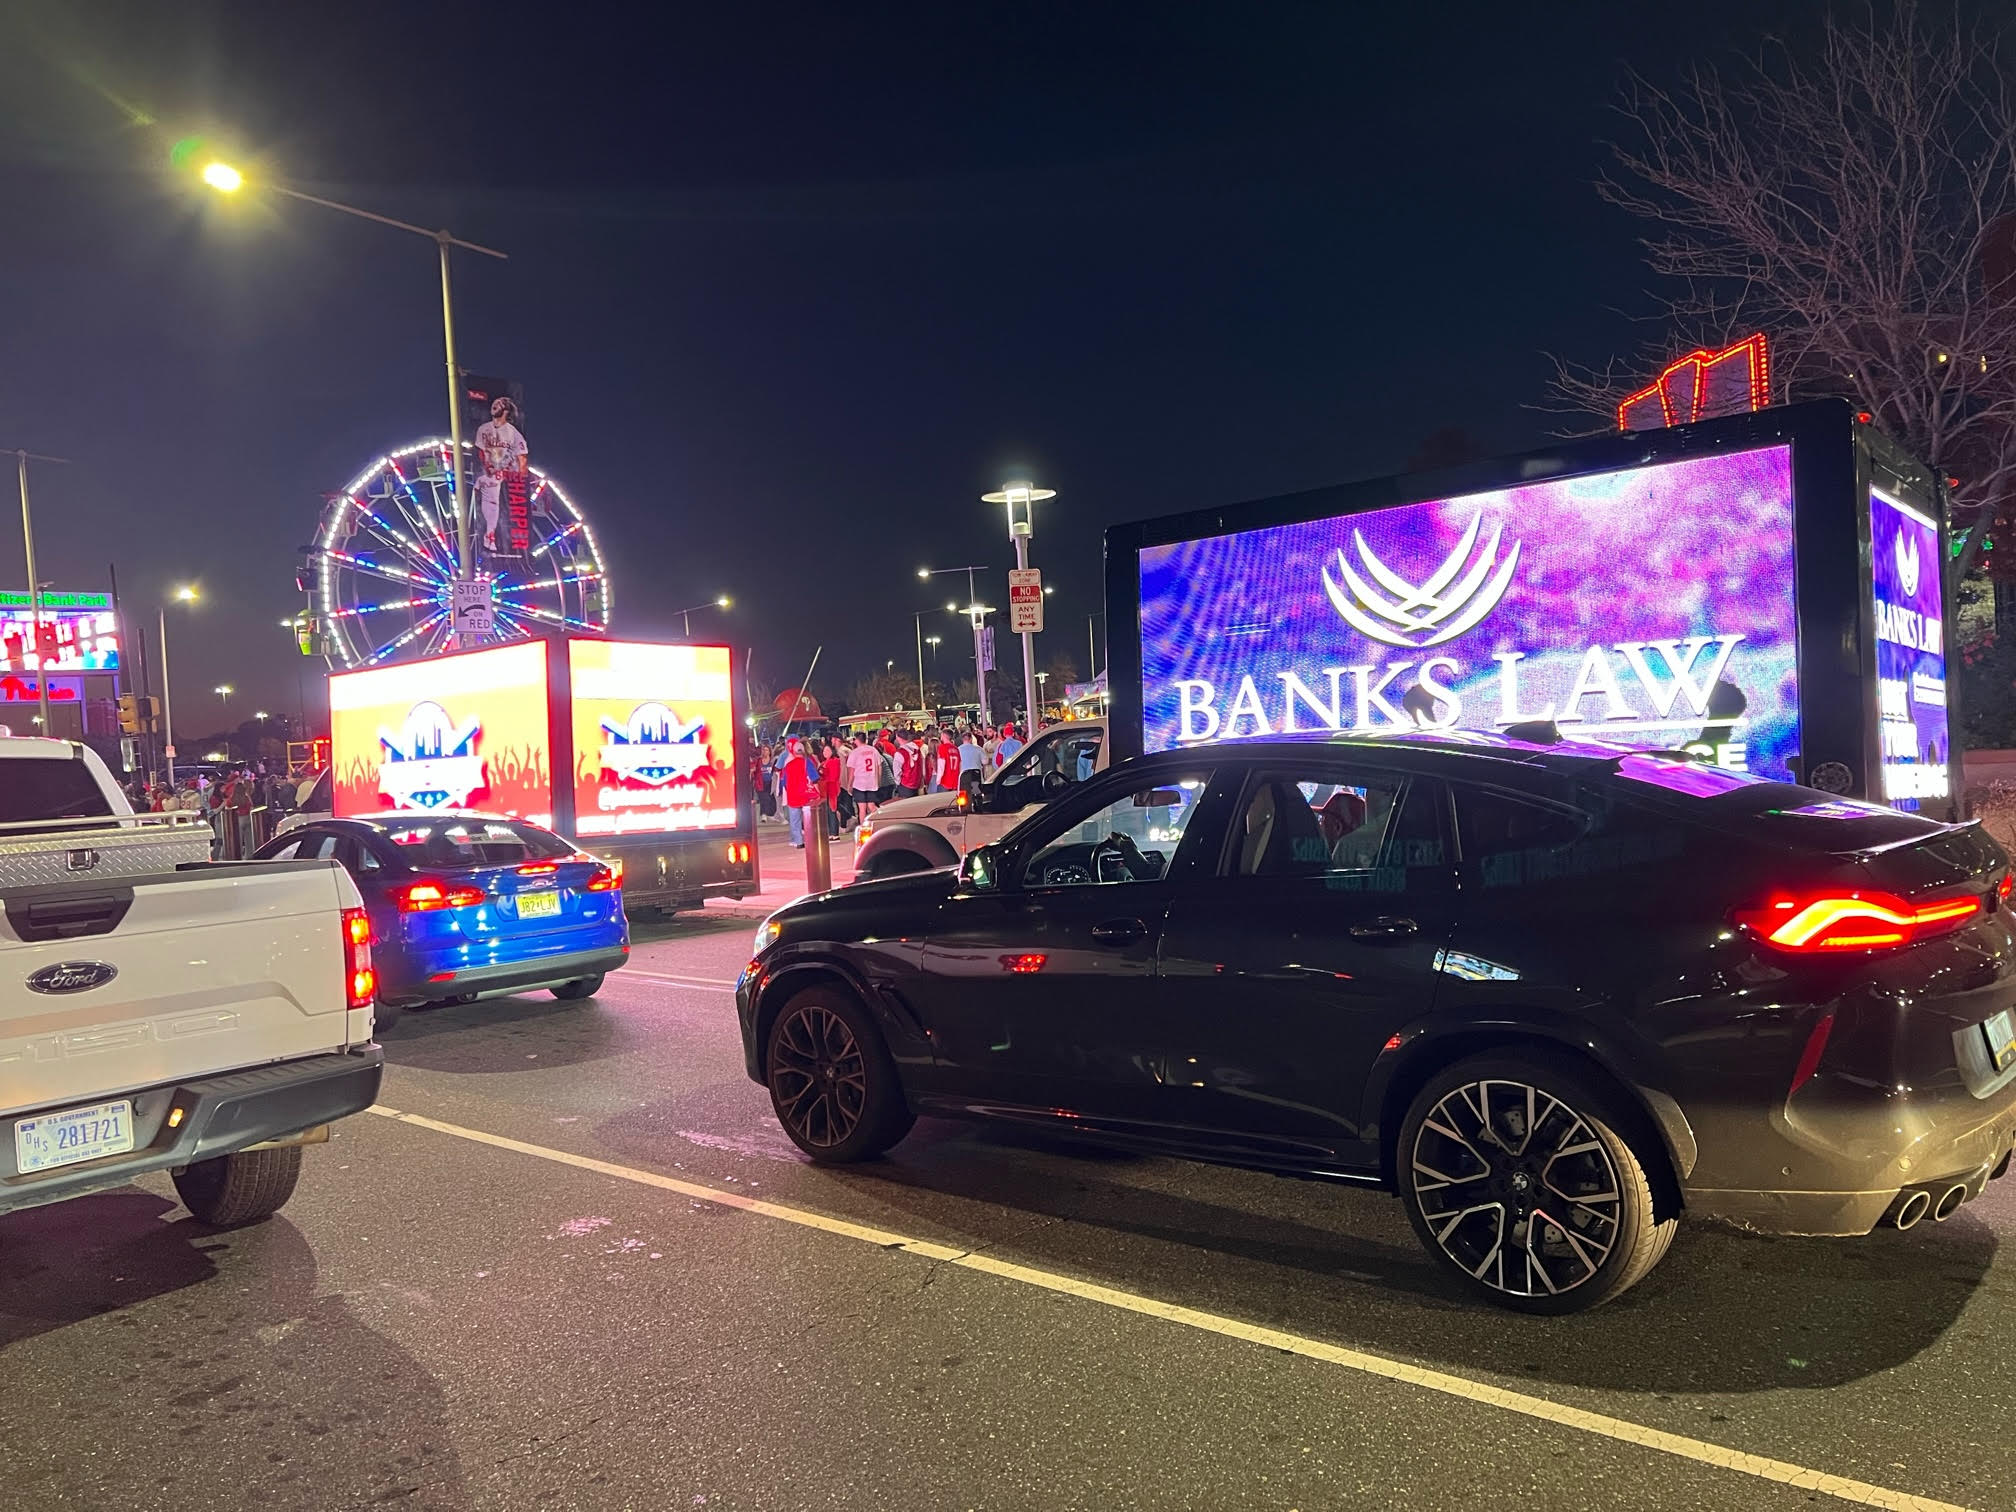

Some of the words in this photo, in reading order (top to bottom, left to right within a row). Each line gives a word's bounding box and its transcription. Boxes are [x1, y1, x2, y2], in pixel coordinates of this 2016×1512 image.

[508, 482, 529, 550] HARPER
[458, 584, 487, 595] STOP
[1020, 586, 1031, 595] NO
[43, 593, 76, 606] Bank
[78, 593, 107, 607] Park
[469, 618, 490, 629] RED
[1173, 656, 1463, 742] BANKS
[1491, 633, 1747, 727] LAW
[865, 758, 873, 772] 2
[949, 755, 959, 771] 17
[49, 966, 99, 989] Ford
[57, 1116, 121, 1150] 281721
